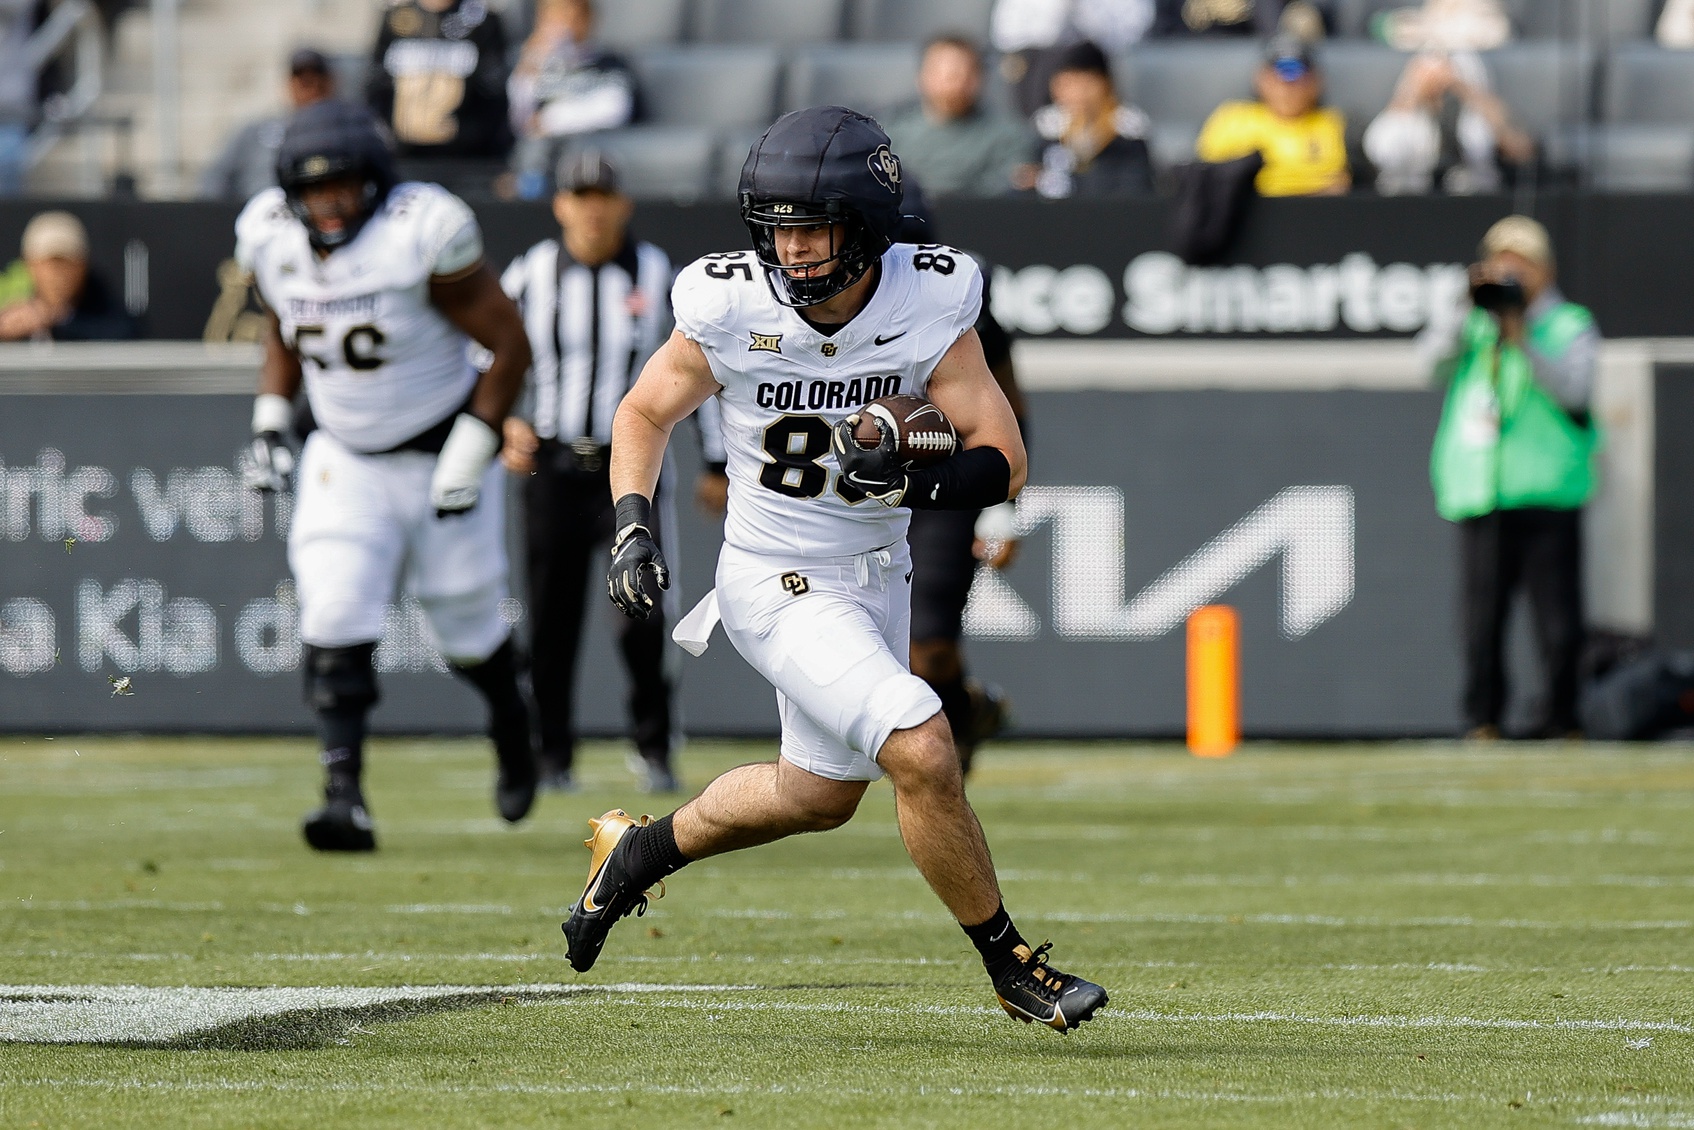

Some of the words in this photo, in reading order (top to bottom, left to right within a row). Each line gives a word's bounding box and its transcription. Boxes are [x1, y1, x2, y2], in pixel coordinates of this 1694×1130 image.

[913, 244, 963, 276] 8
[1122, 251, 1469, 335] Smarter
[756, 375, 902, 411] COLORADO
[0, 447, 119, 542] ric
[757, 413, 873, 507] 8
[75, 577, 220, 677] Kia
